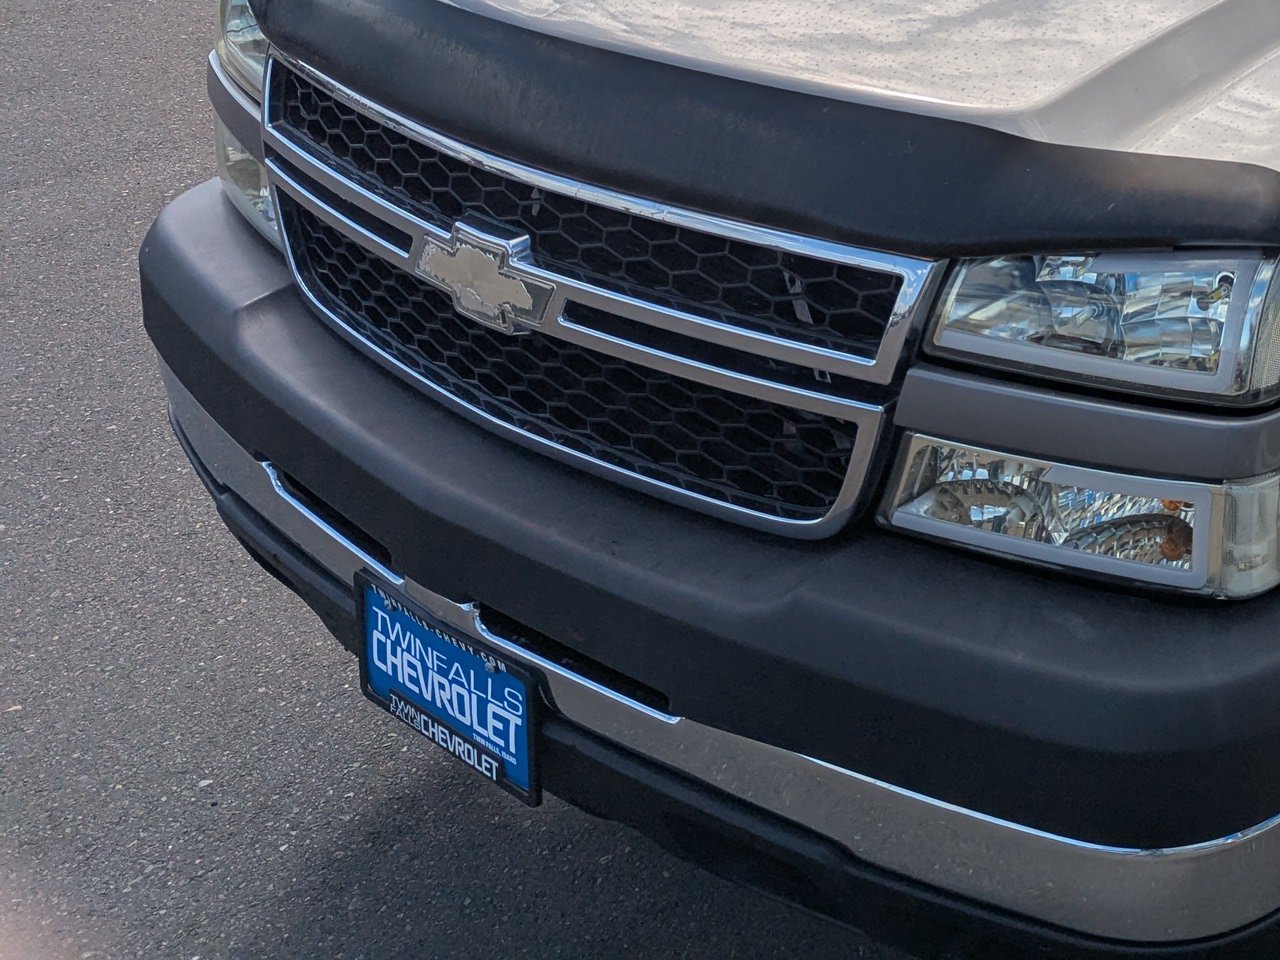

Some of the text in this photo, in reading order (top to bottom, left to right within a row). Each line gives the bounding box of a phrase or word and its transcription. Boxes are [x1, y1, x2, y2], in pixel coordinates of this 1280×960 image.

[372, 629, 522, 755] CHEVROLET
[390, 693, 420, 720] TWIN
[390, 703, 421, 731] FALLS
[420, 713, 499, 781] CHEVROLET
